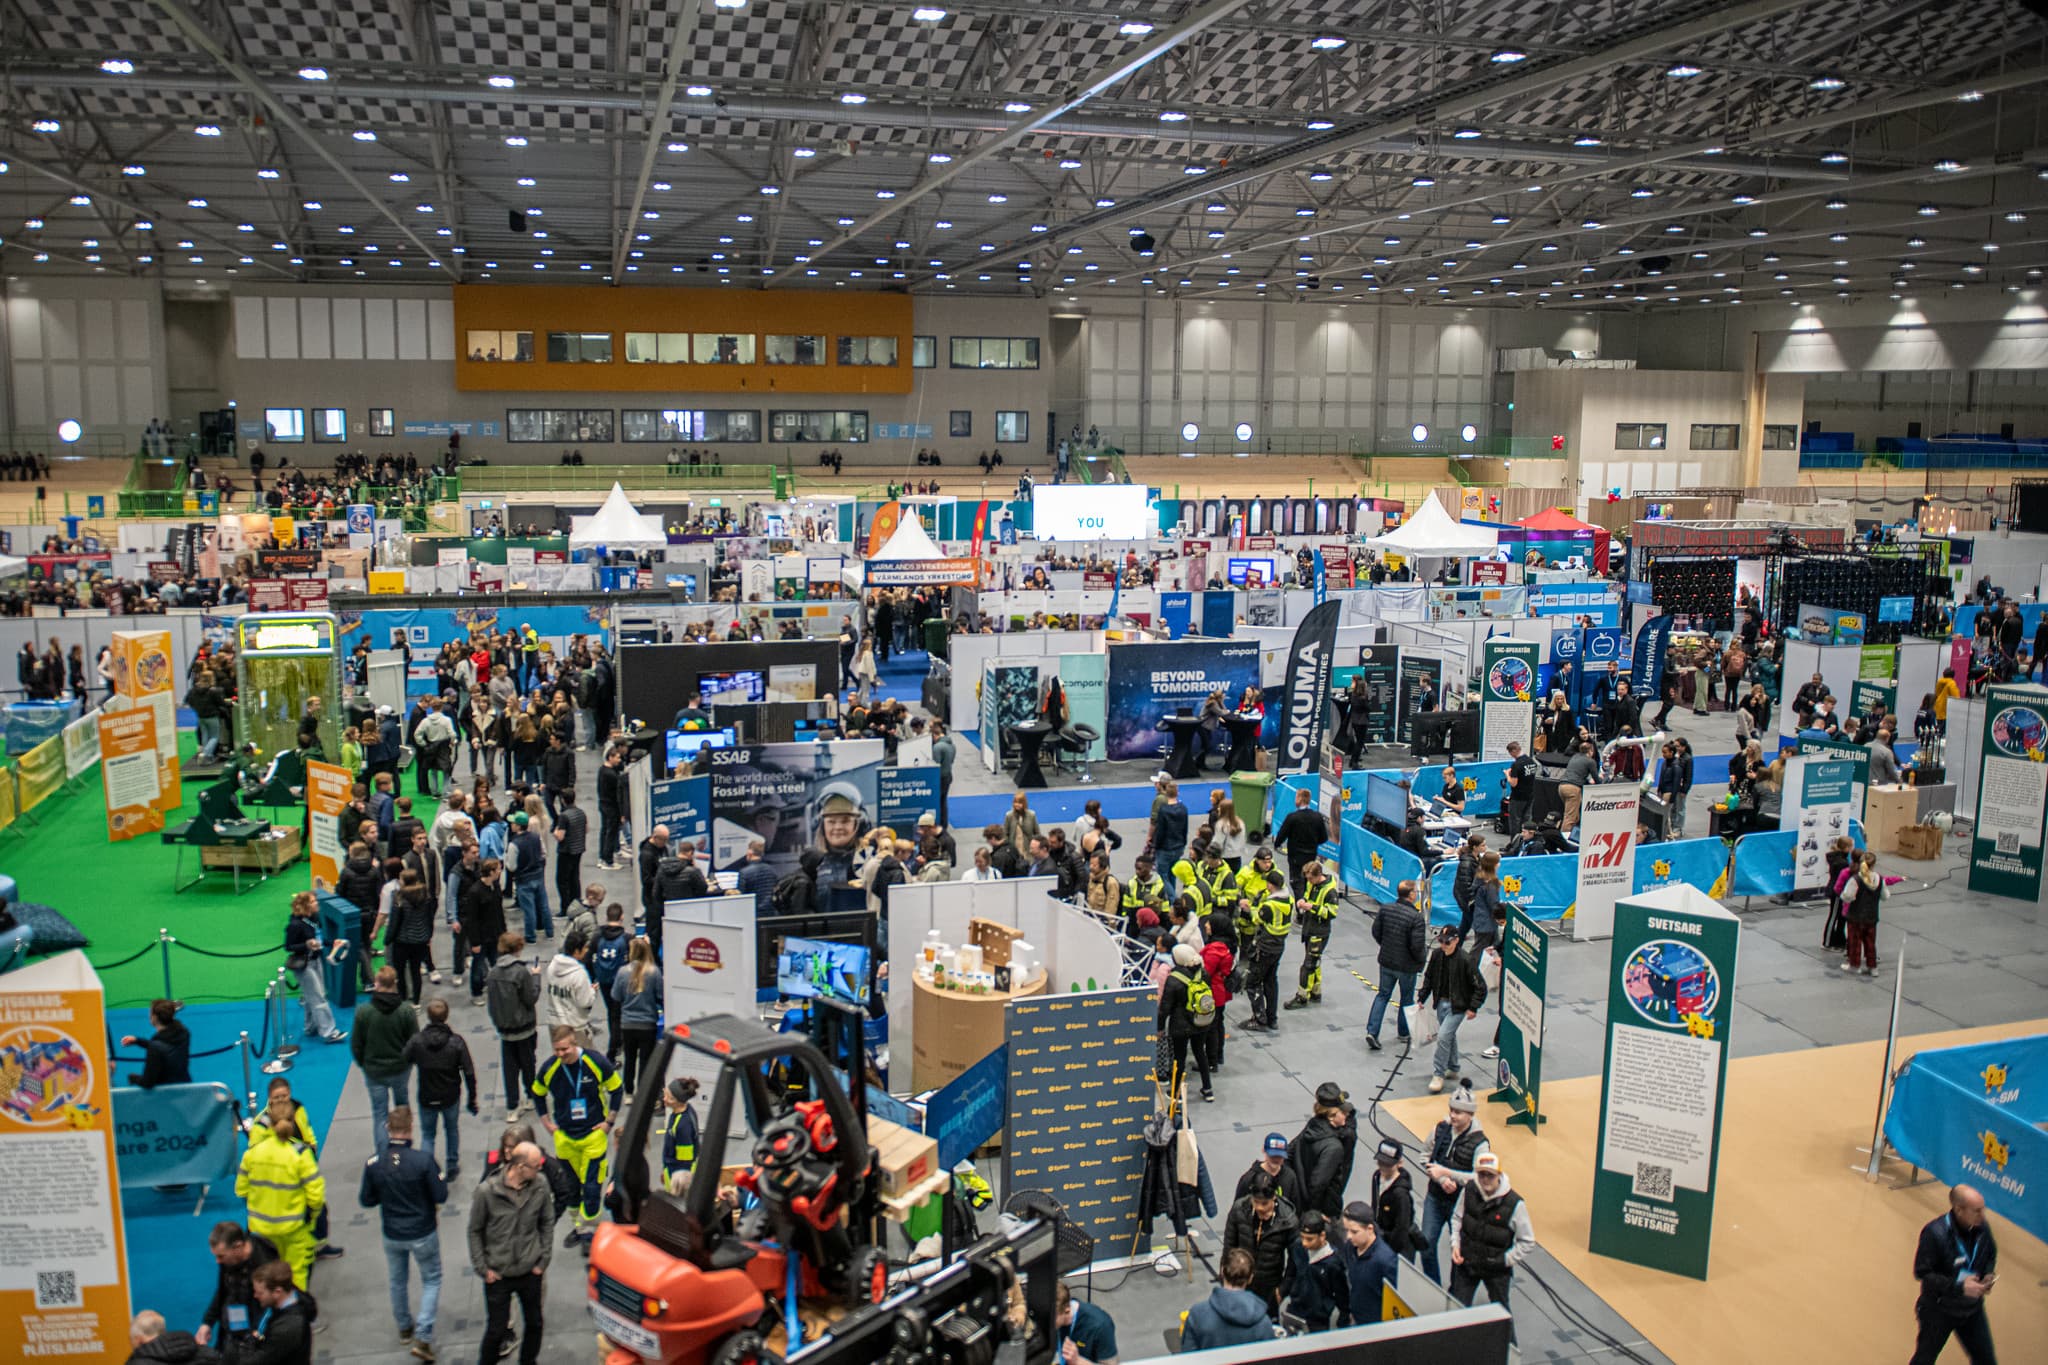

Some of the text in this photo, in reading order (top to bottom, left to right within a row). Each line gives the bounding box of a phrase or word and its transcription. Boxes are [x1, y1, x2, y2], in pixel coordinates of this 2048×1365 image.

[1077, 517, 1104, 528] YOU
[875, 572, 925, 581] VÄRMLANDS
[1222, 648, 1258, 658] compare
[1643, 628, 1659, 682] LearnWARE
[1064, 678, 1104, 690] compare
[1151, 671, 1206, 682] BEYOND
[1150, 681, 1231, 693] TOMORROW
[1288, 641, 1320, 760] OKUMA
[1309, 653, 1329, 747] OPEN POSSIBILITIES
[712, 750, 751, 765] SSAB
[713, 770, 795, 785] The world needs
[712, 781, 806, 798] Fossil-free steel
[892, 788, 932, 798] fossil-free
[881, 797, 900, 806] steel
[1584, 800, 1636, 811] Mastercam
[1512, 916, 1541, 950] SVETSARE
[1648, 917, 1703, 935] SVETSARE
[118, 1120, 158, 1138] nga
[154, 1135, 208, 1152] 2024
[1961, 1153, 2026, 1198] Yrkes-SM
[1624, 1213, 1677, 1235] SVETSARE
